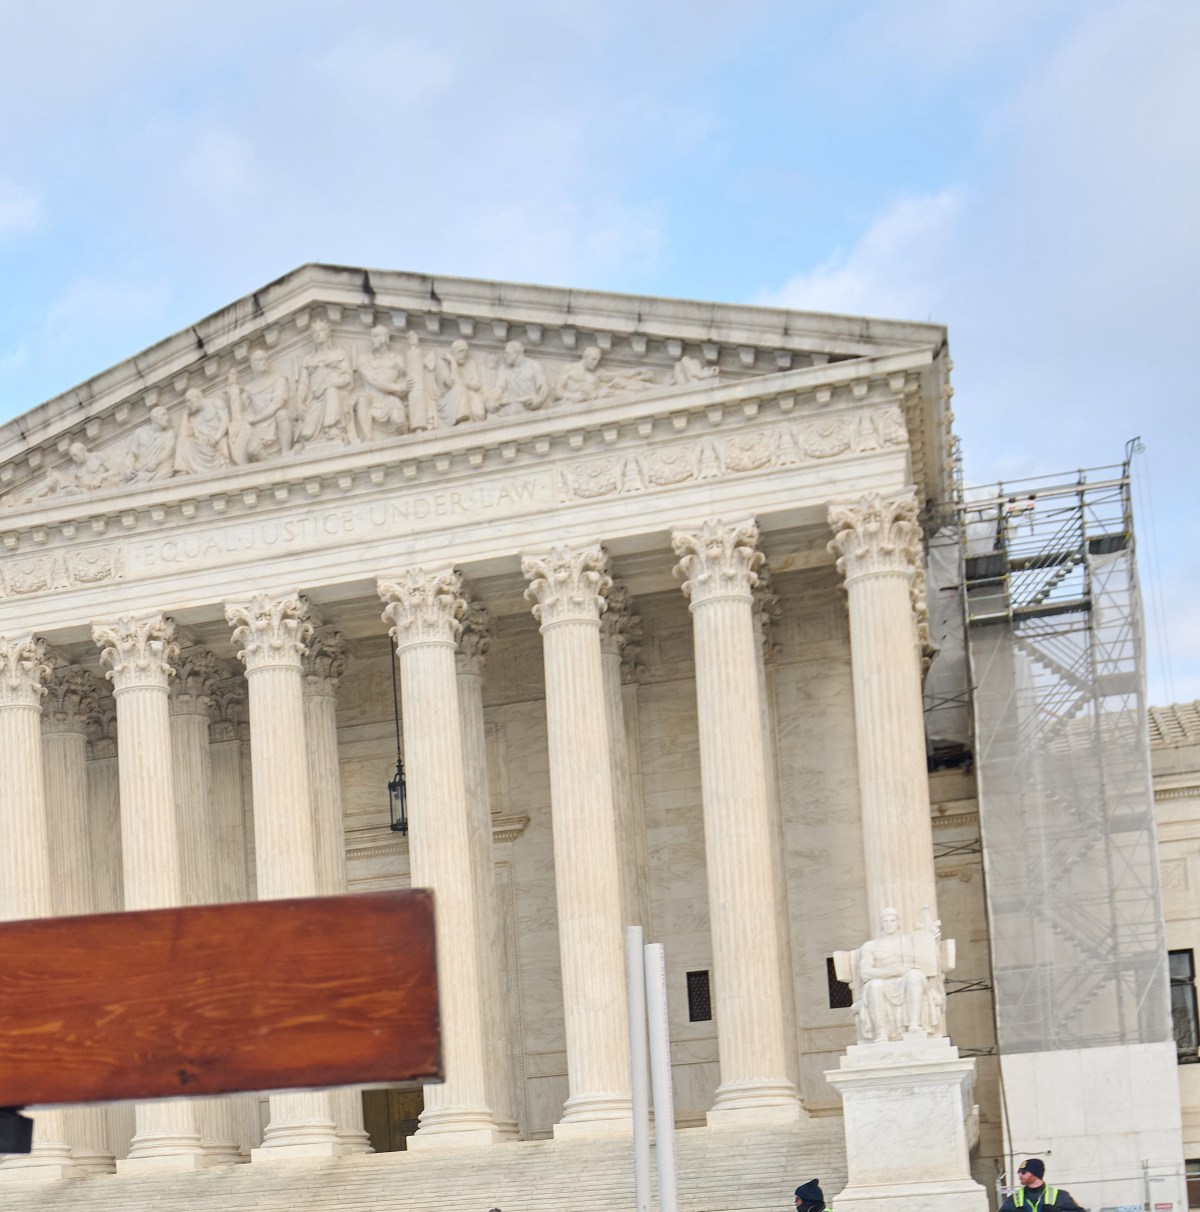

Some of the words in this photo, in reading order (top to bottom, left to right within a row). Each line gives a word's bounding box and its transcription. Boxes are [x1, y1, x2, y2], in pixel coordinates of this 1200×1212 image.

[144, 532, 238, 566] EQUAL
[244, 513, 355, 549] JUSTICE
[369, 491, 472, 526] UNDER
[479, 478, 537, 509] LAW
